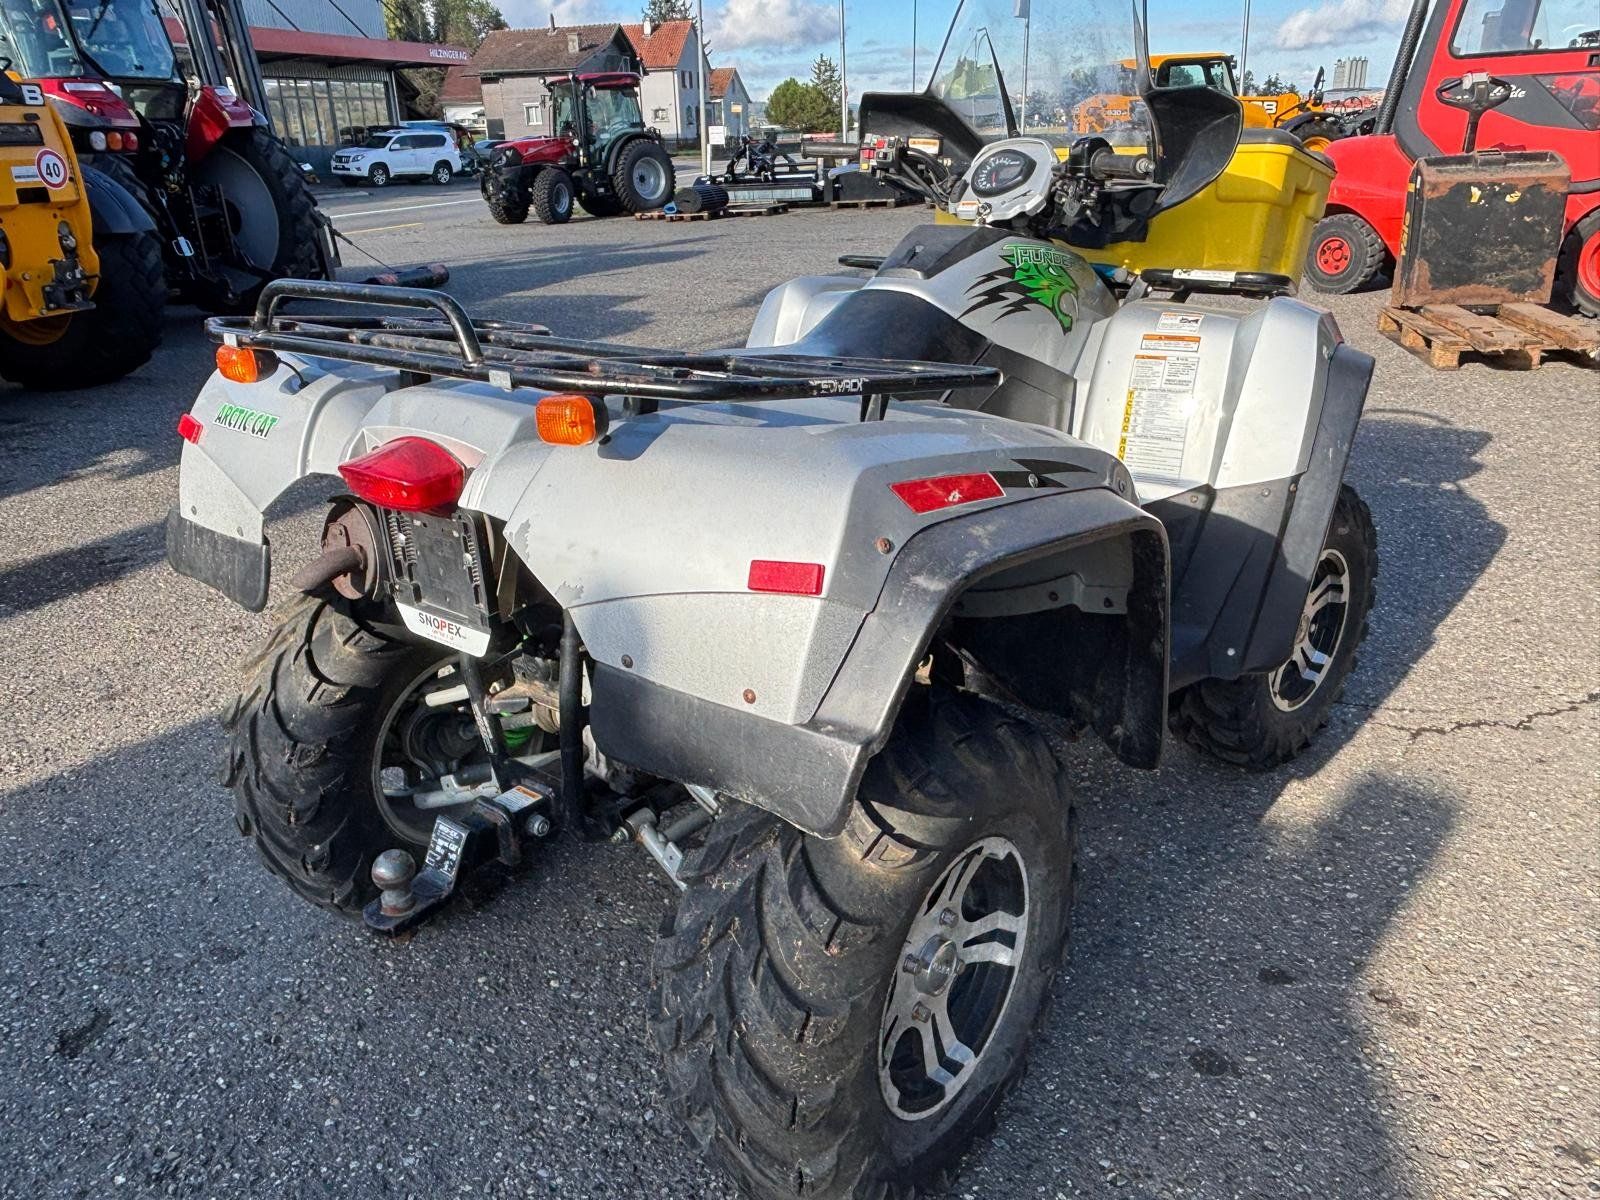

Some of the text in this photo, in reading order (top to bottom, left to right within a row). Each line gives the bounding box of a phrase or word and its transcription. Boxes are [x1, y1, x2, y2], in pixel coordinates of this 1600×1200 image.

[429, 48, 458, 59] HILZINGER
[45, 163, 60, 178] 40
[214, 403, 278, 438] ARCTIC CAT
[418, 612, 461, 639] SNOPEX
